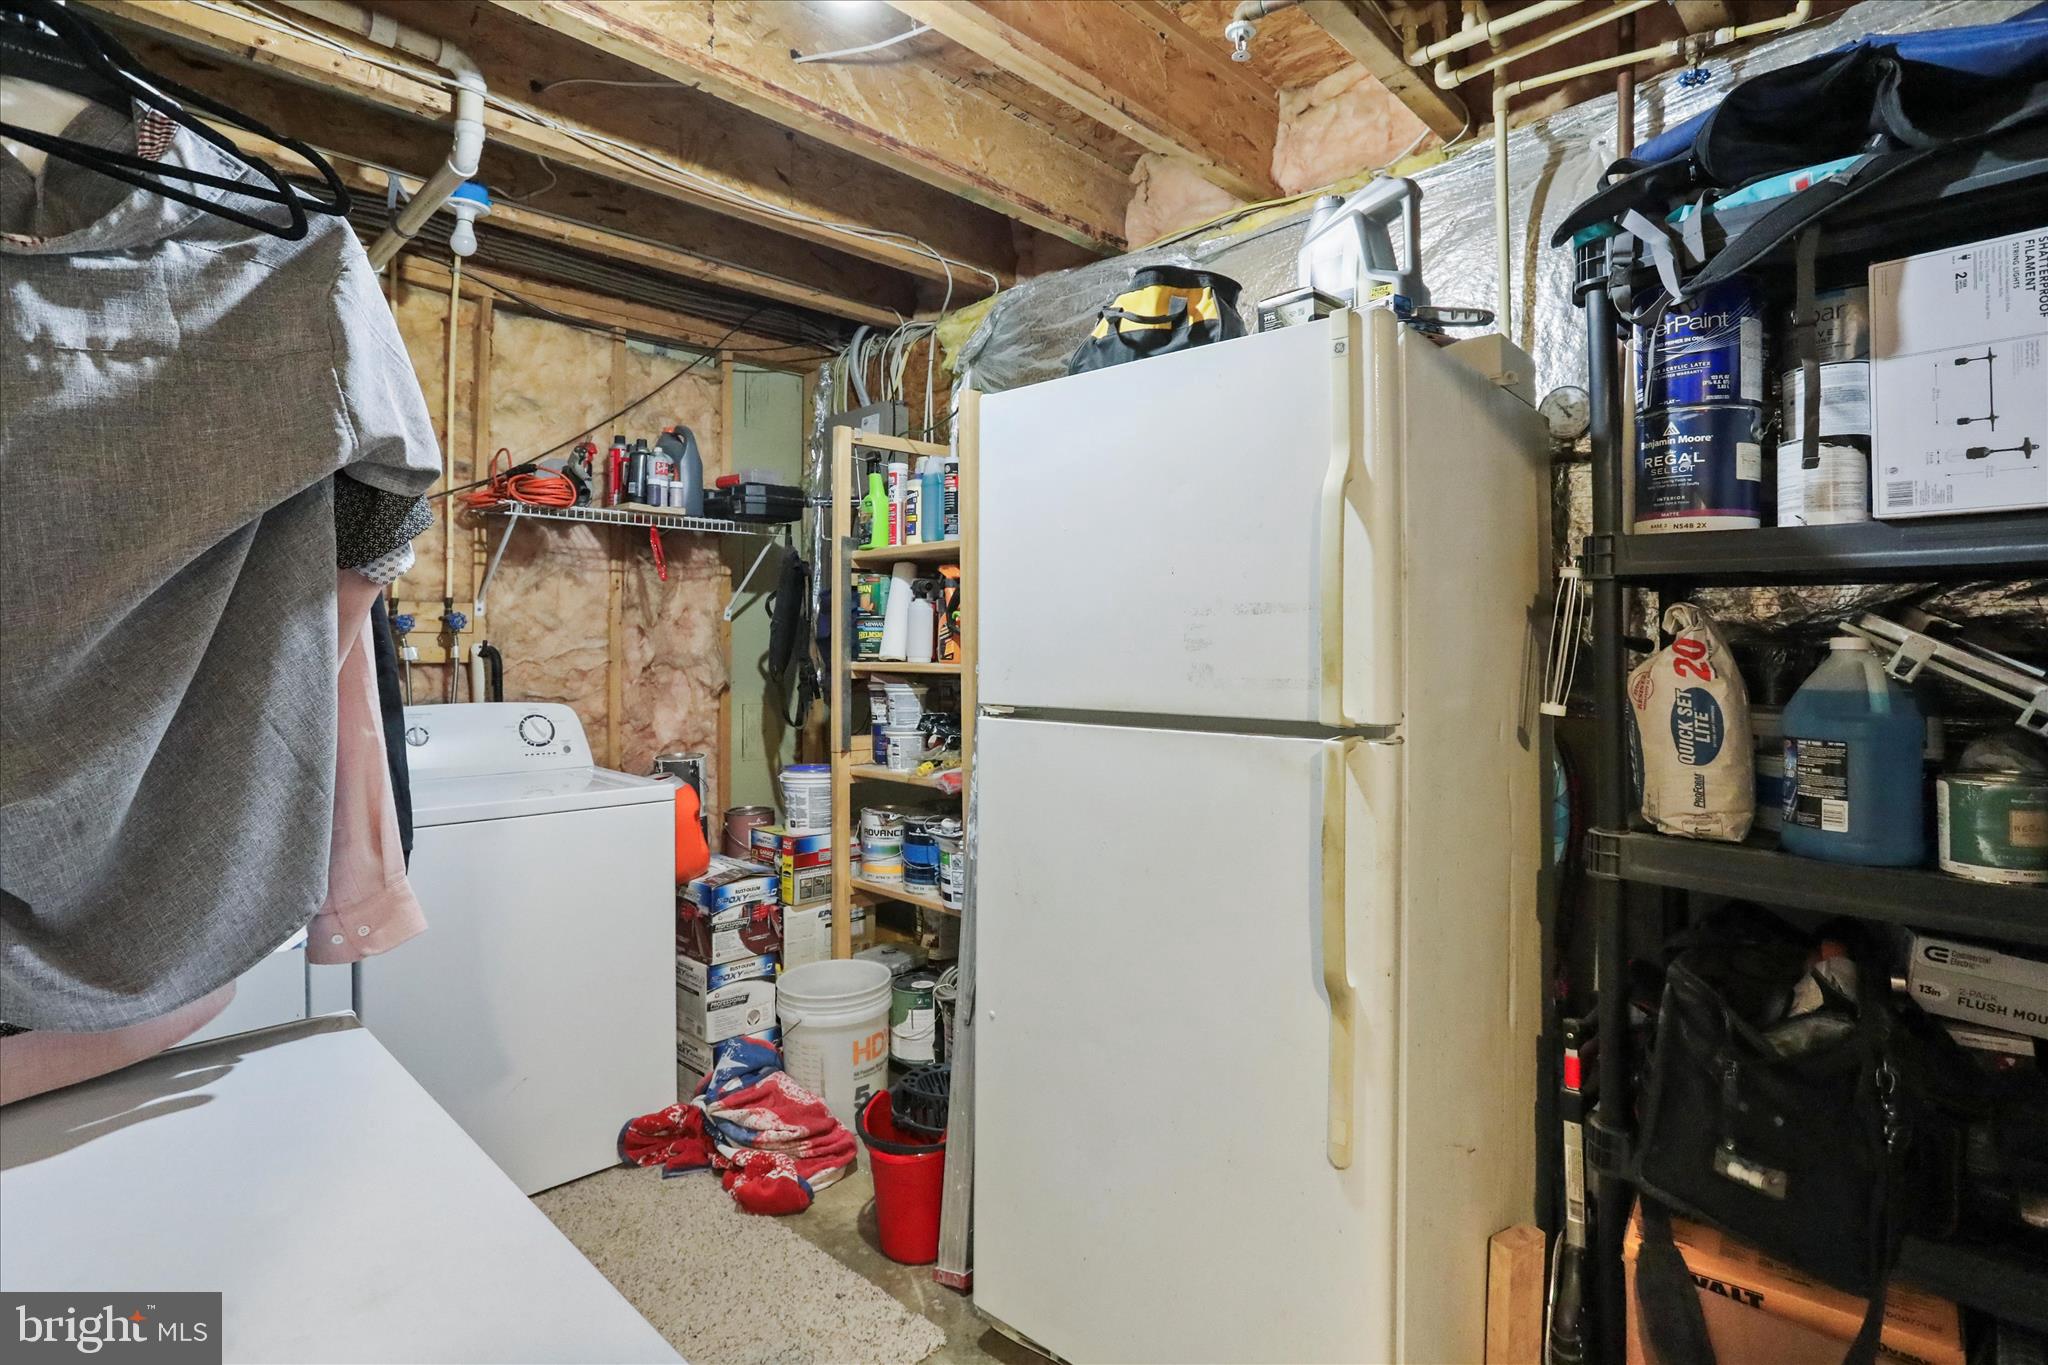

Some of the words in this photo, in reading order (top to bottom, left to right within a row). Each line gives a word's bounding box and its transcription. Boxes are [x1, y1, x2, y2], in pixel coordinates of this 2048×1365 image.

[2012, 242, 2020, 266] STRING
[2025, 239, 2036, 292] FILAMENT
[1955, 271, 1968, 280] 2
[2012, 267, 2020, 289] LIGHTS
[2039, 236, 2048, 317] SHATTERPROOF
[1690, 361, 1711, 369] LATEX
[1640, 436, 1676, 452] Benjamin
[1678, 433, 1714, 445] Moore
[1644, 451, 1706, 469] REGAL
[1650, 464, 1696, 476] SELECT
[1696, 521, 1708, 529] 2X
[1672, 637, 1711, 682] 20
[1675, 688, 1695, 718] SET
[1694, 710, 1712, 743] LITE
[1678, 719, 1697, 765] QUICK
[1950, 957, 1976, 970] Electric
[1951, 949, 1992, 965] Commercial
[1919, 984, 1941, 998] 13in
[1958, 987, 1998, 1002] 2-PACK
[1957, 996, 2008, 1016] FLUSH
